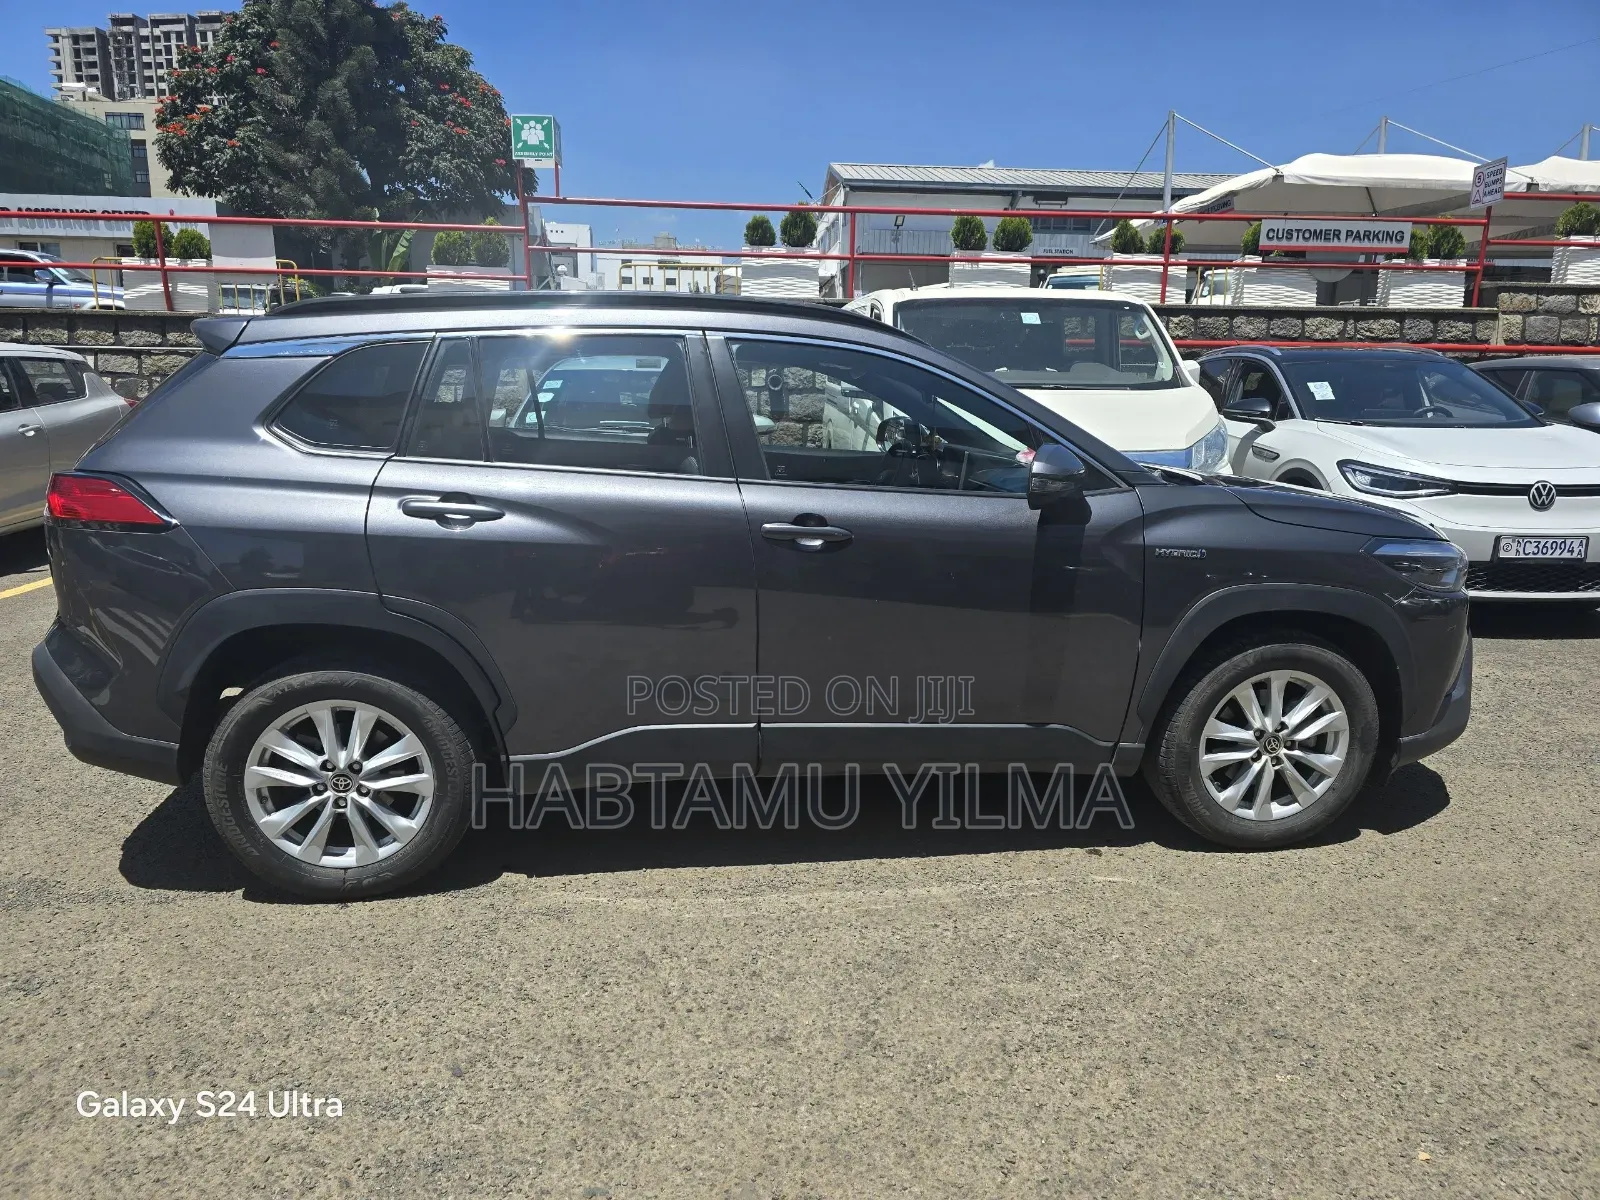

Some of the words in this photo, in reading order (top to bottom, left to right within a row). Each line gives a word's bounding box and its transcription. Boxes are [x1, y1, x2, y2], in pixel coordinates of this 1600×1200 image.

[1486, 168, 1503, 179] SPEED
[1485, 177, 1503, 188] BUMPS
[1484, 187, 1502, 197] AHEAD
[1265, 227, 1342, 242] CUSTOMER
[1345, 229, 1406, 244] PARKING
[1522, 539, 1575, 556] C36994
